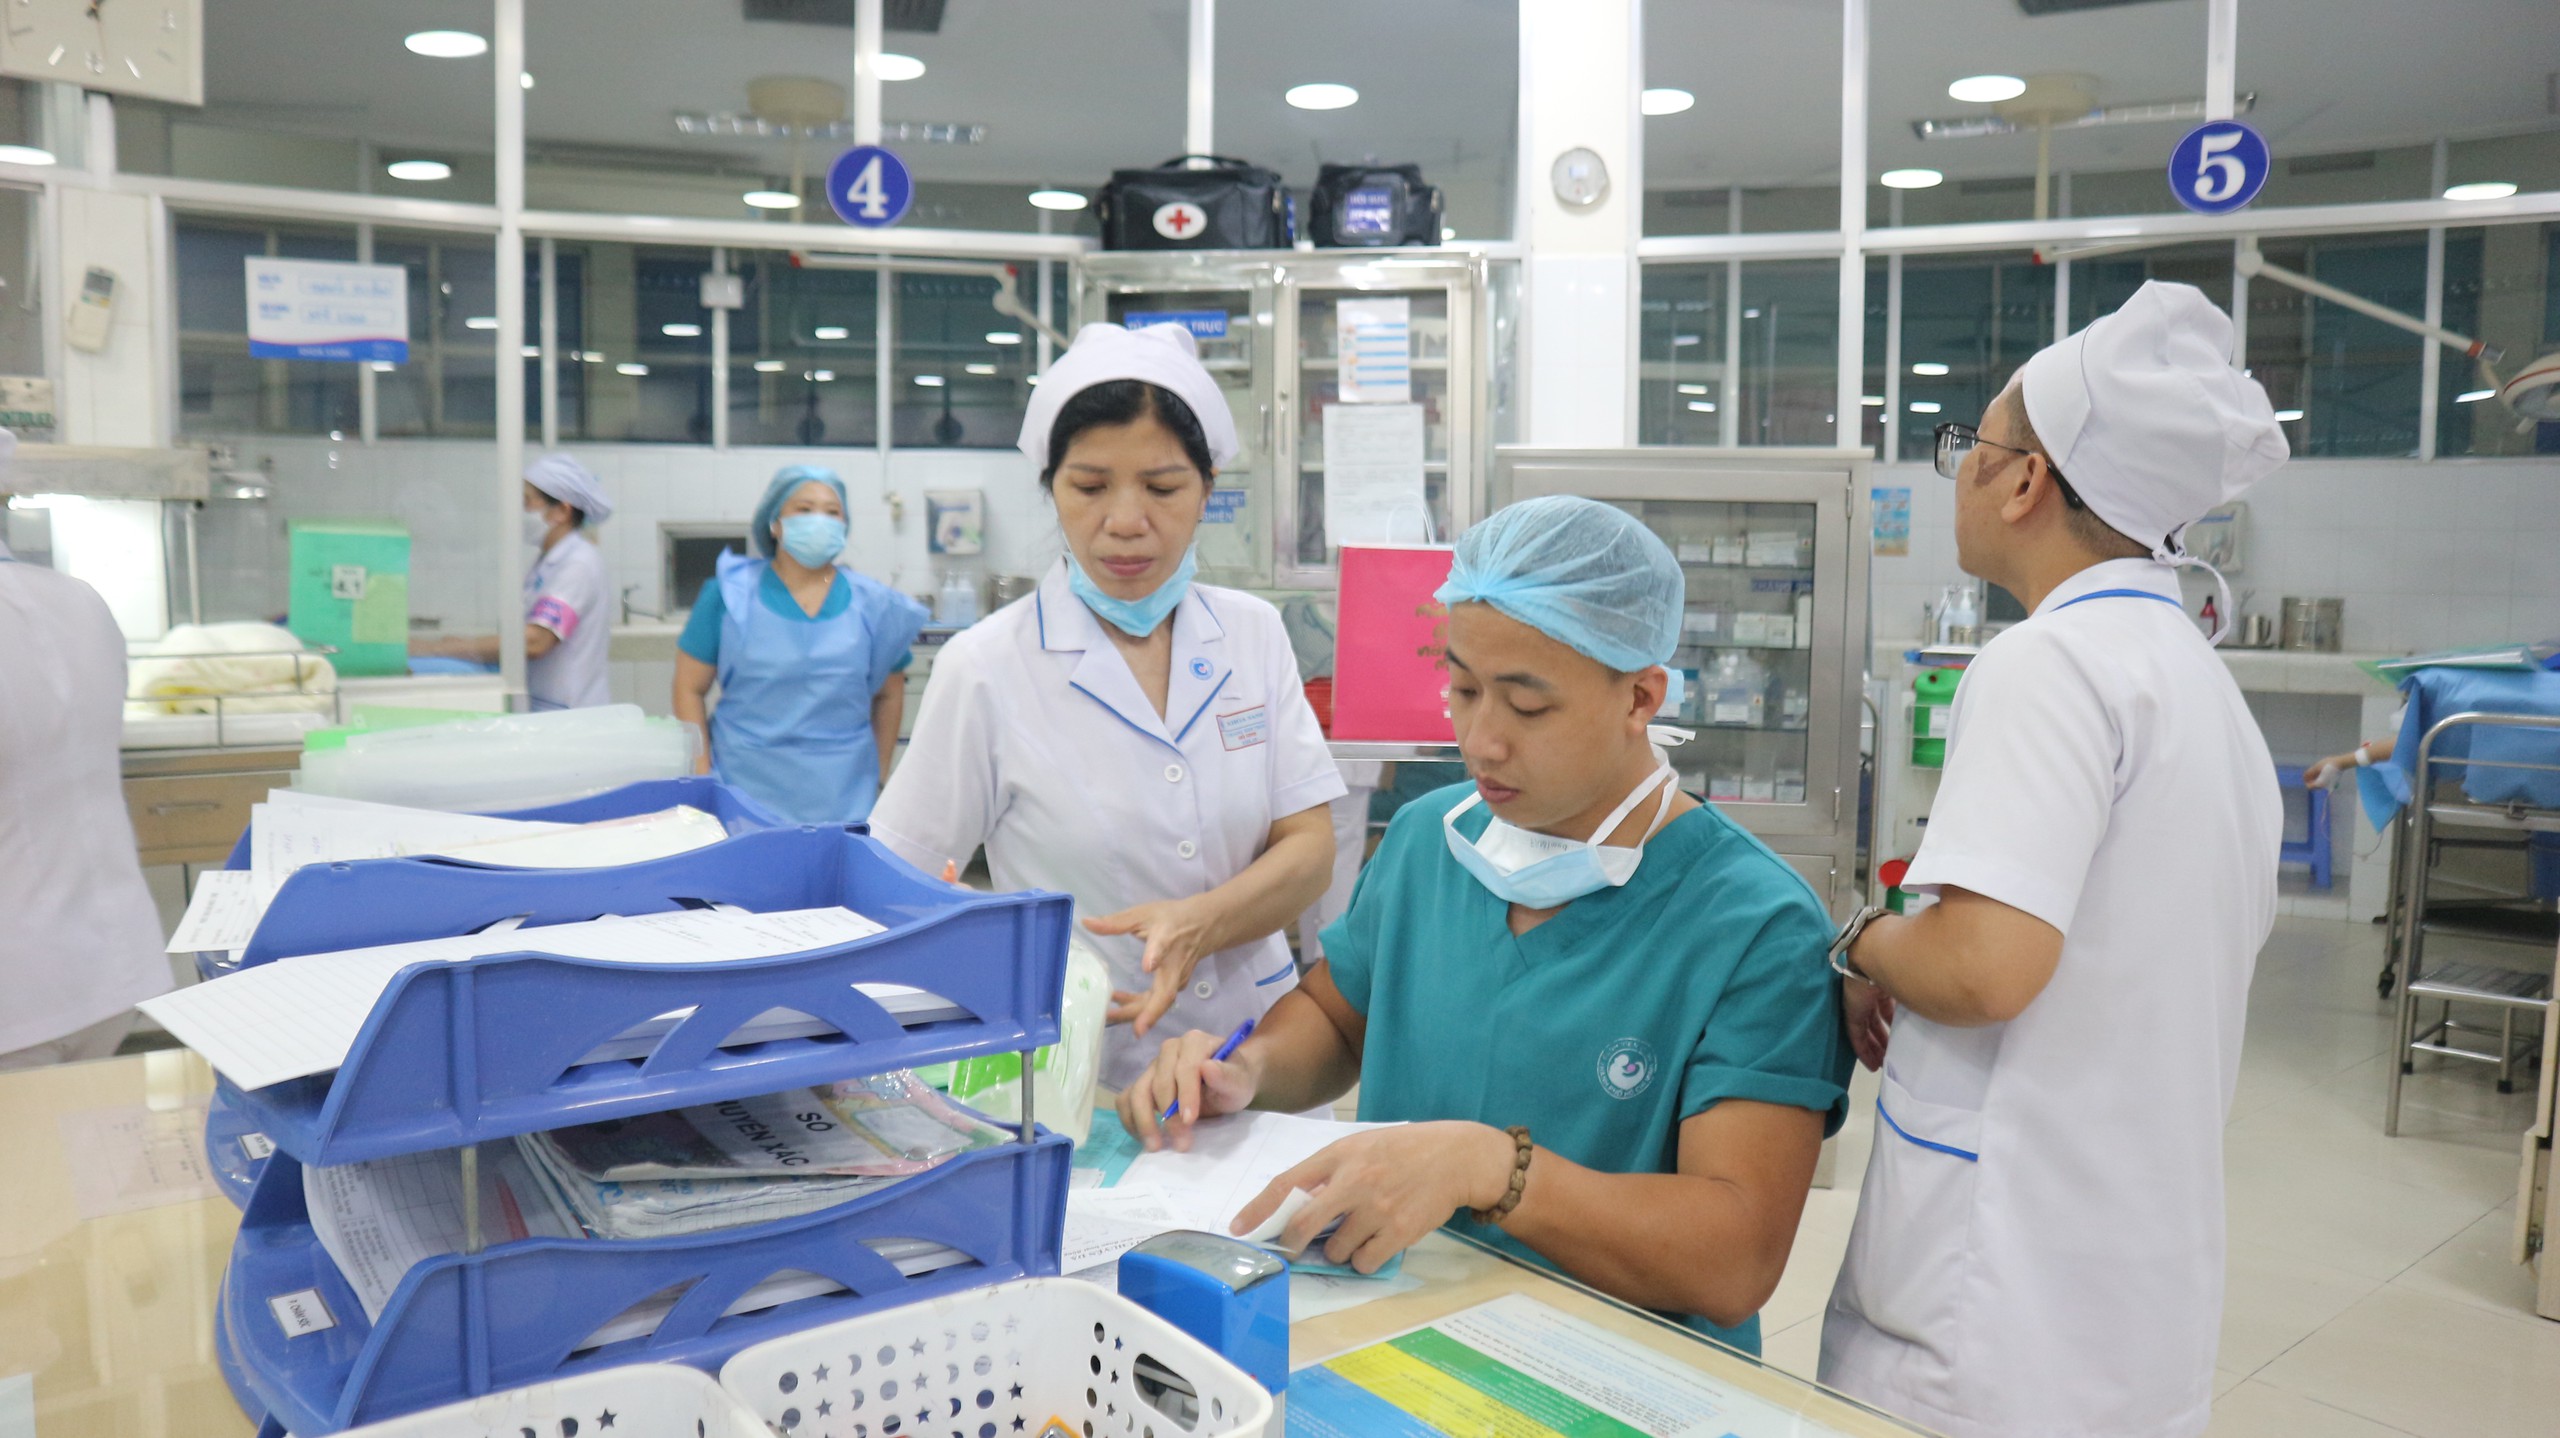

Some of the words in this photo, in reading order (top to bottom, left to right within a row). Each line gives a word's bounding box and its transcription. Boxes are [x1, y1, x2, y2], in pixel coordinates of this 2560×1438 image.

[847, 155, 889, 218] 4
[2194, 130, 2246, 202] 5
[758, 1142, 810, 1166] XÁC
